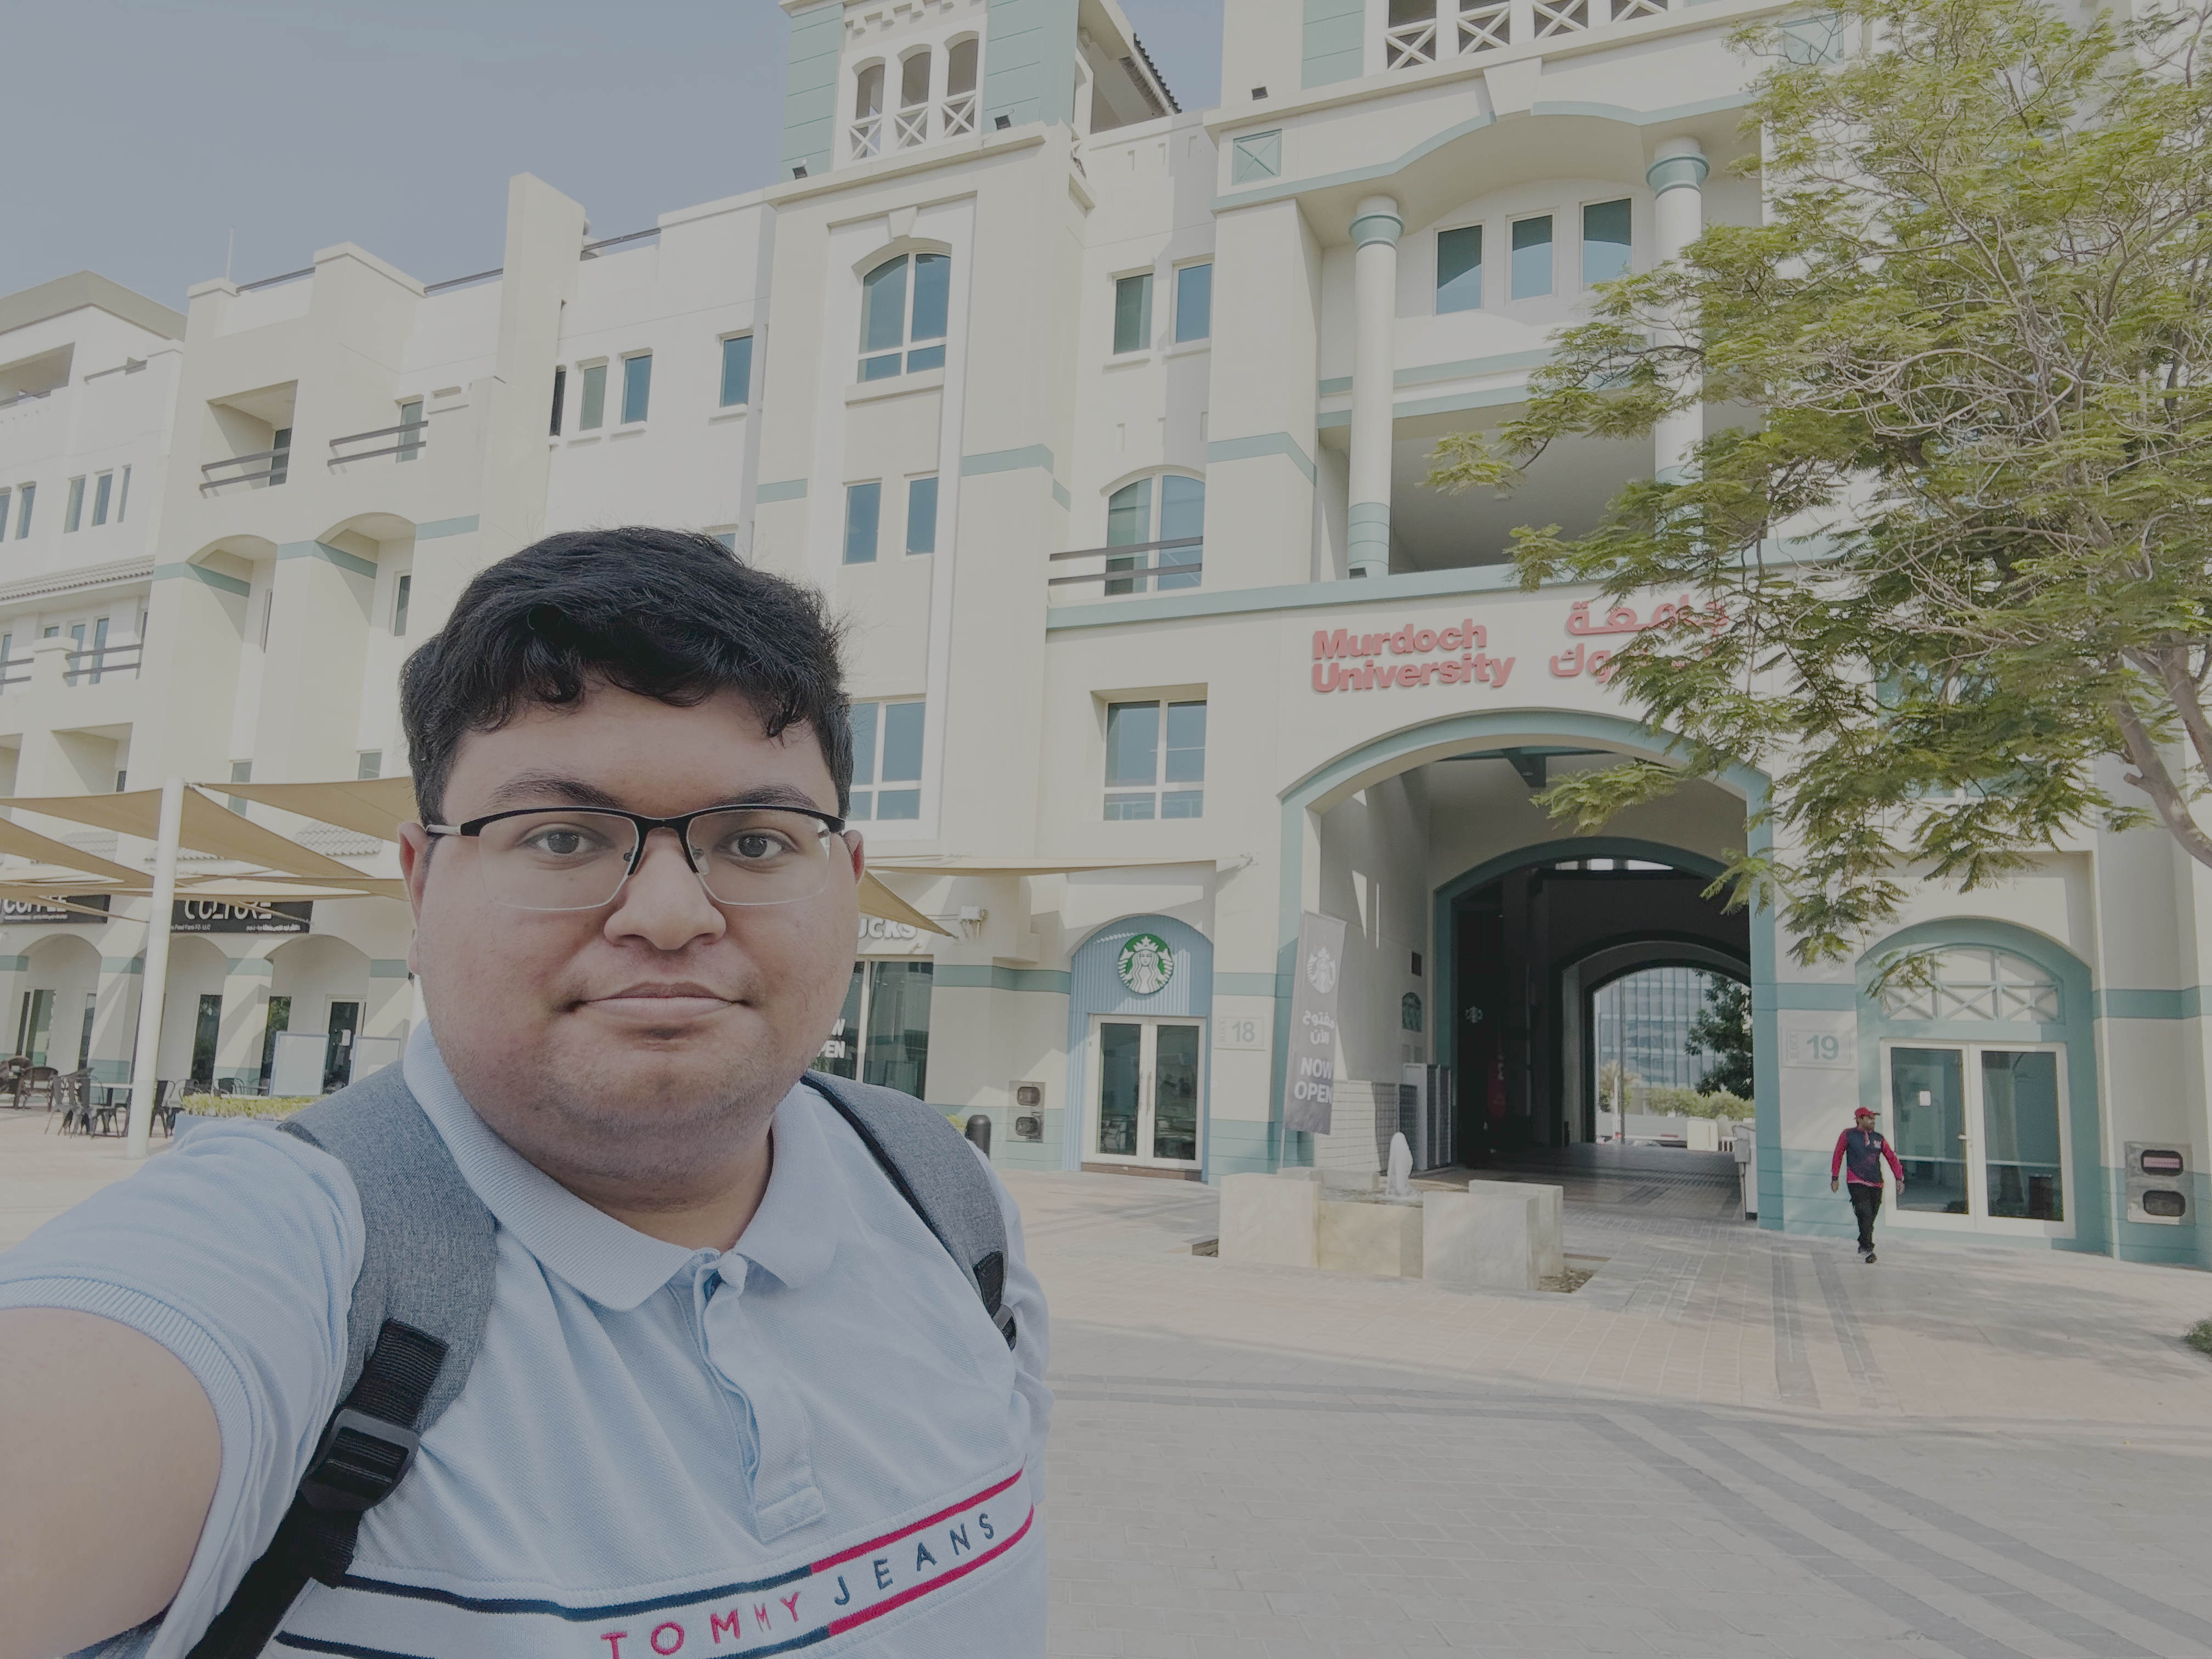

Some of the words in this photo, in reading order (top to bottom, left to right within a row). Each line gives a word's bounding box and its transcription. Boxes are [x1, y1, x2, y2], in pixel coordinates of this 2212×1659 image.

[1313, 618, 1487, 660] Murdoch
[1312, 652, 1516, 692] University
[1302, 1010, 1335, 1029] مفتوح
[1231, 1021, 1256, 1043] 18
[1807, 1035, 1839, 1060] 19
[1300, 1057, 1333, 1080] NOW
[1294, 1080, 1333, 1104] OPEN
[601, 1592, 800, 1659] TOMMY
[834, 1513, 995, 1605] JEANS
